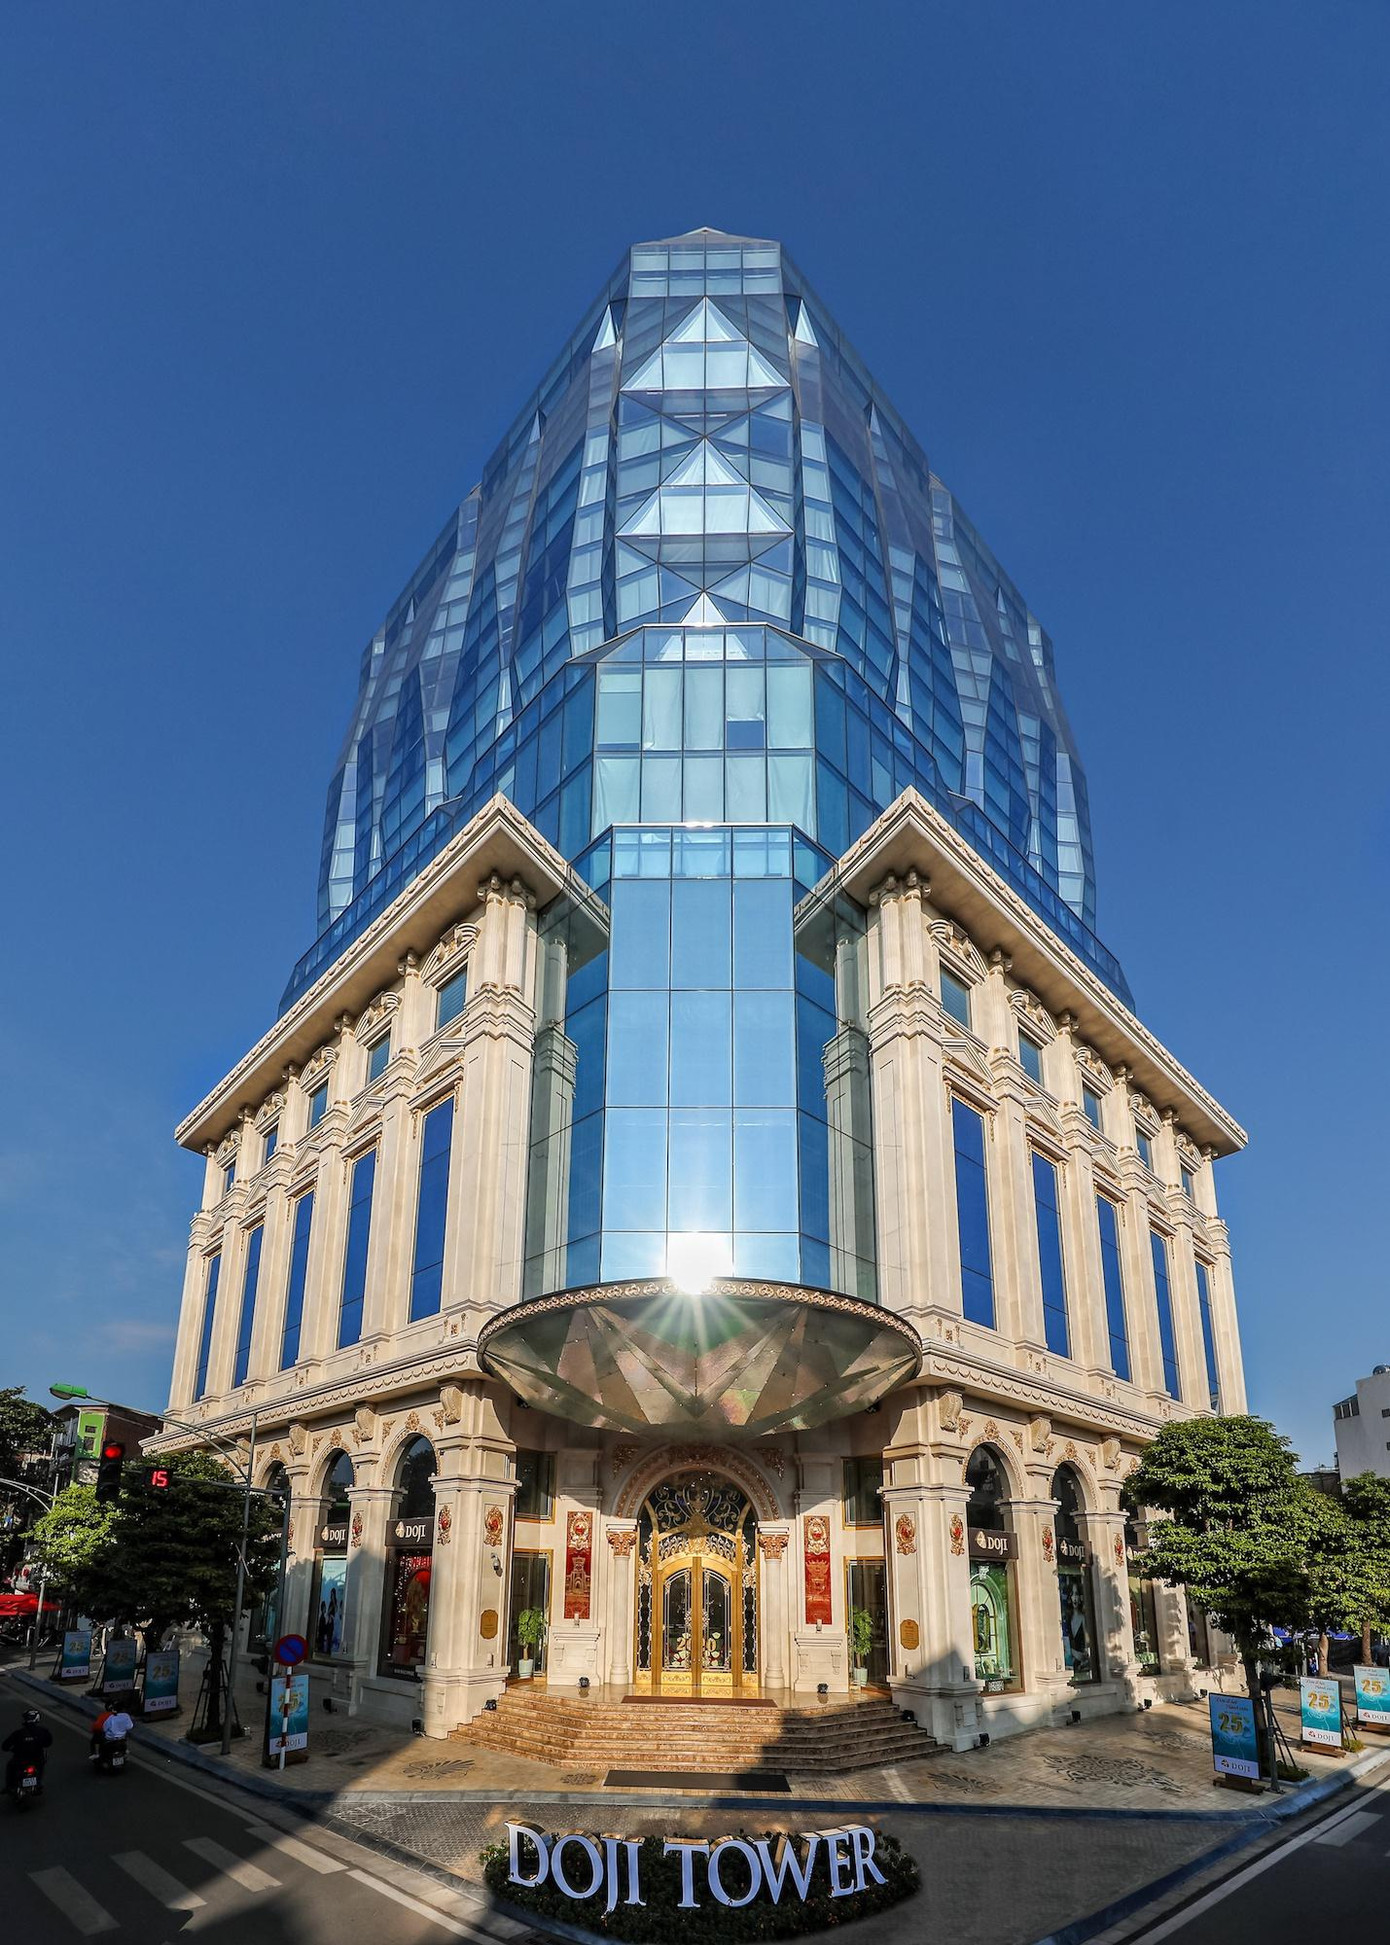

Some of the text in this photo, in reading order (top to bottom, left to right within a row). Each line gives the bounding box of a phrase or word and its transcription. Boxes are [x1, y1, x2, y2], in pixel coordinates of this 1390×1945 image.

[152, 1471, 168, 1487] 15
[329, 1529, 346, 1545] DOJI
[405, 1524, 427, 1543] DOJI
[988, 1537, 1008, 1556] DOJI
[1069, 1545, 1085, 1560] DOJI
[1317, 1733, 1335, 1742] DOJI
[1231, 1762, 1250, 1773] DOJI
[504, 1821, 888, 1918] DOJI TOWER
